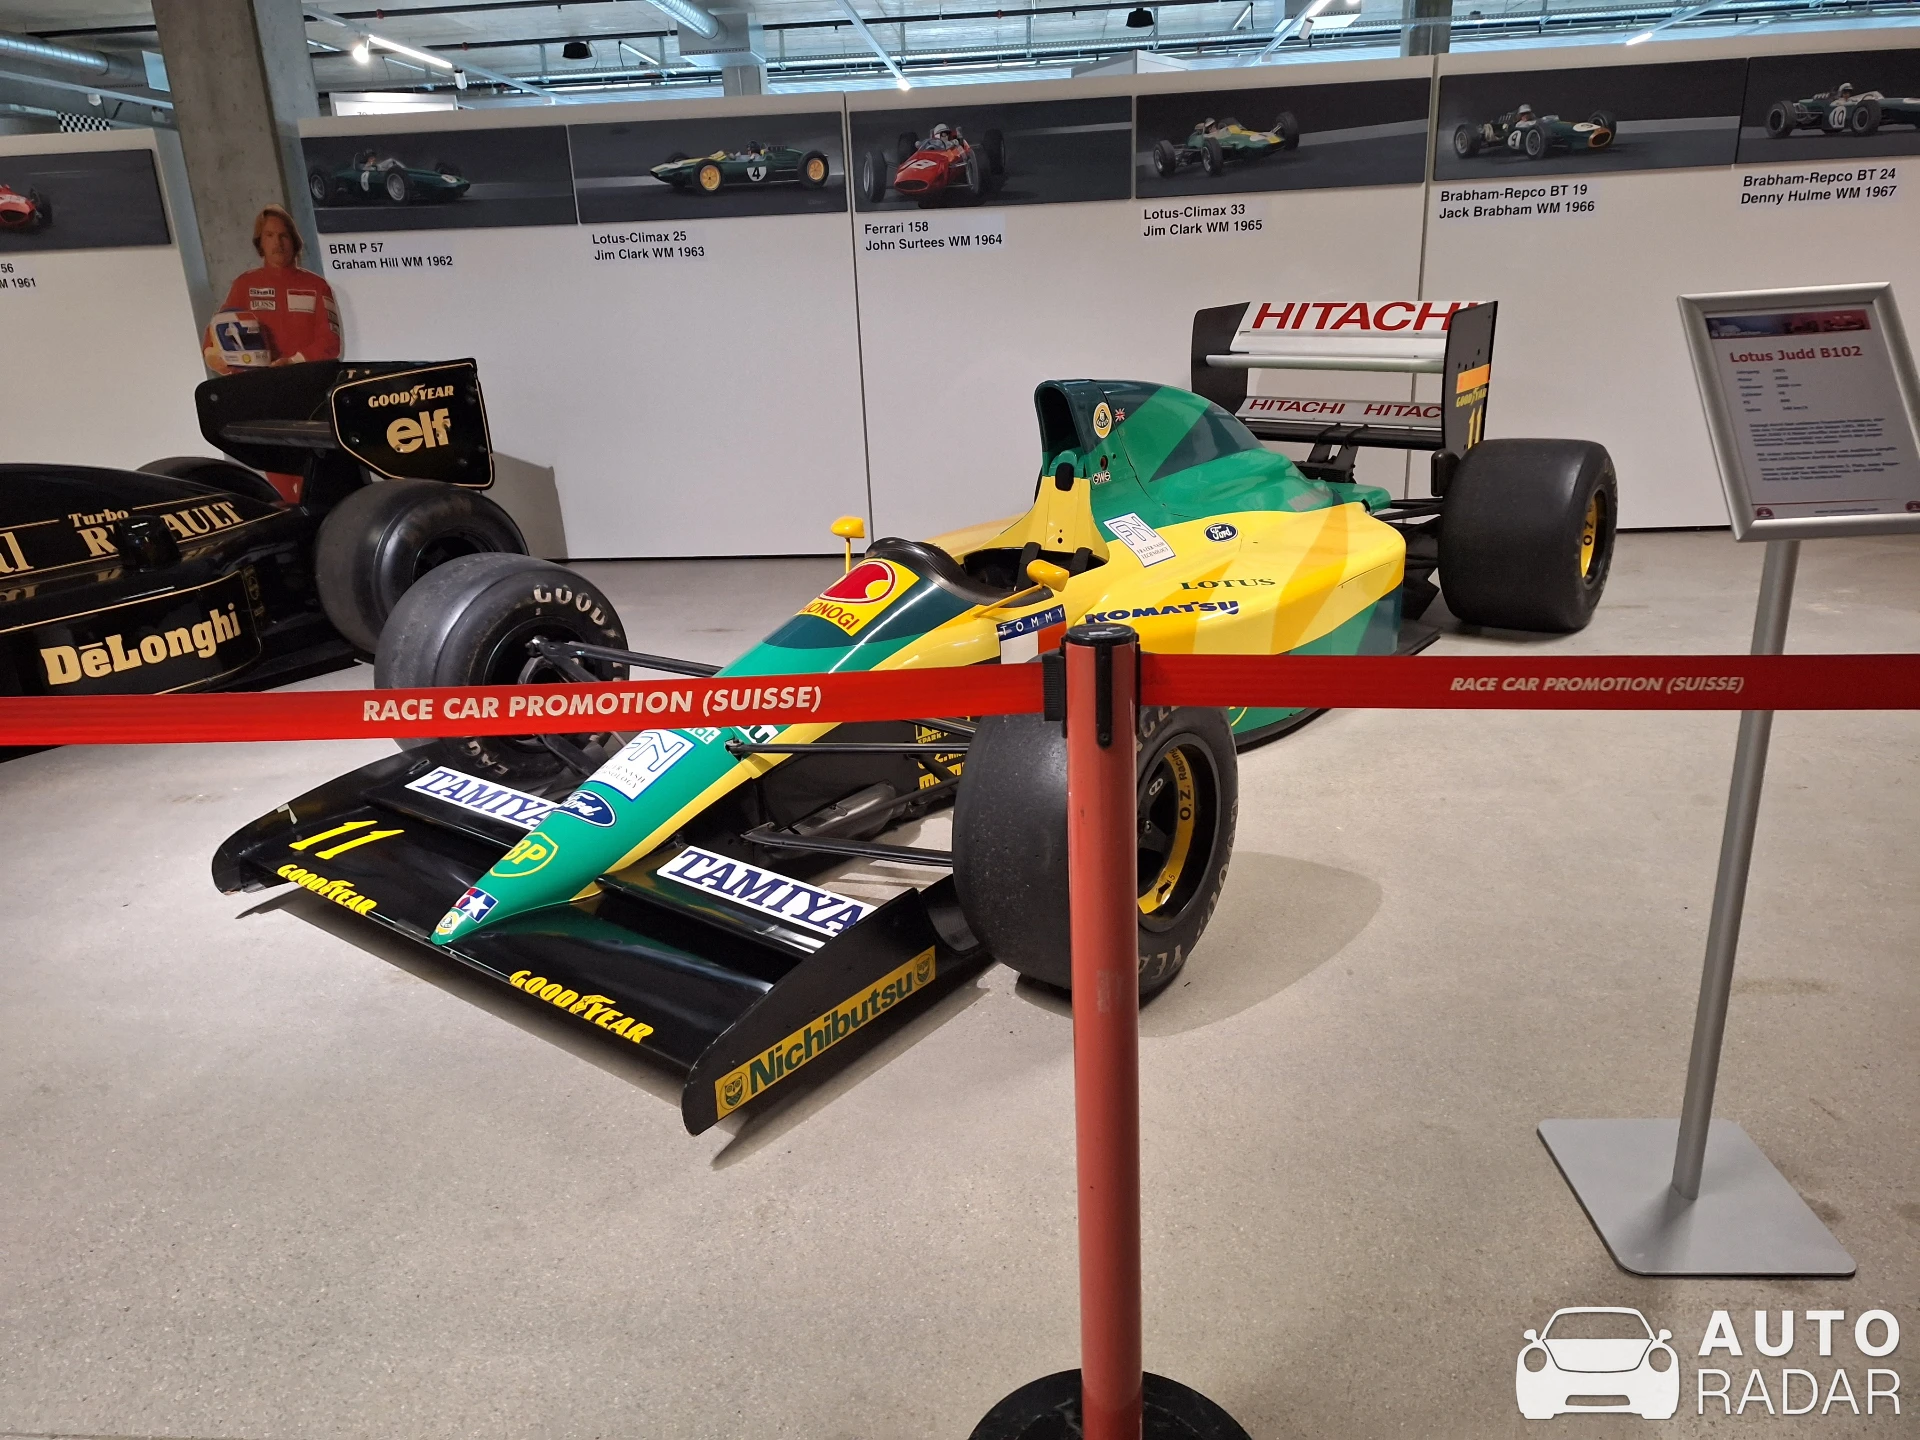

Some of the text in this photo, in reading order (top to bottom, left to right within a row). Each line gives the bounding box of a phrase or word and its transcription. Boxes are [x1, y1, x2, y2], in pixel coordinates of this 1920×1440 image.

[752, 167, 760, 180] 4
[1743, 168, 1896, 187] Brabham-Repco BT 24
[1440, 184, 1588, 202] Brabham-Repco BT 19
[1741, 186, 1897, 205] Denny Hulme WM 1967
[1144, 204, 1246, 220] Lotus-Climax 33
[1440, 201, 1595, 219] Jack Brabham WM 1966
[592, 230, 687, 244] Lotus-Climax 25
[864, 222, 929, 234] Ferrari 158
[1144, 220, 1262, 236] Jim Clark WM 1965
[329, 242, 384, 254] BRM P 57
[866, 234, 1002, 251] John Surtees WM 1964
[594, 246, 705, 260] Jim Clark WM 1963
[0, 262, 14, 274] 56
[332, 256, 453, 270] Graham Hill WM 1962
[0, 277, 36, 288] M 1961
[1252, 302, 1478, 331] HITACH
[1729, 345, 1864, 364] Lotus Judd B102
[368, 384, 454, 408] GOODYEAR
[1249, 400, 1442, 418] HITACHI HITAC
[386, 408, 451, 454] elf
[1468, 405, 1482, 450] 11
[68, 508, 129, 528] Turbo
[76, 500, 244, 557] RAULT
[1208, 524, 1234, 540] Ford
[1180, 578, 1276, 590] LOTUS
[1000, 607, 1064, 636] TOMMY
[1084, 600, 1240, 624] KOMATSU
[1450, 676, 1744, 694] RACE CAR PROMOTION (SUISSE)
[363, 686, 822, 722] RACE CAR PROMOTION (SUISSE)
[289, 820, 404, 860] 11
[502, 840, 547, 866] BP
[277, 864, 380, 916] GOODYEAR
[668, 849, 871, 933] TAMIYA
[508, 970, 654, 1044] GOODYEAR
[750, 968, 912, 1094] Nichibutsu
